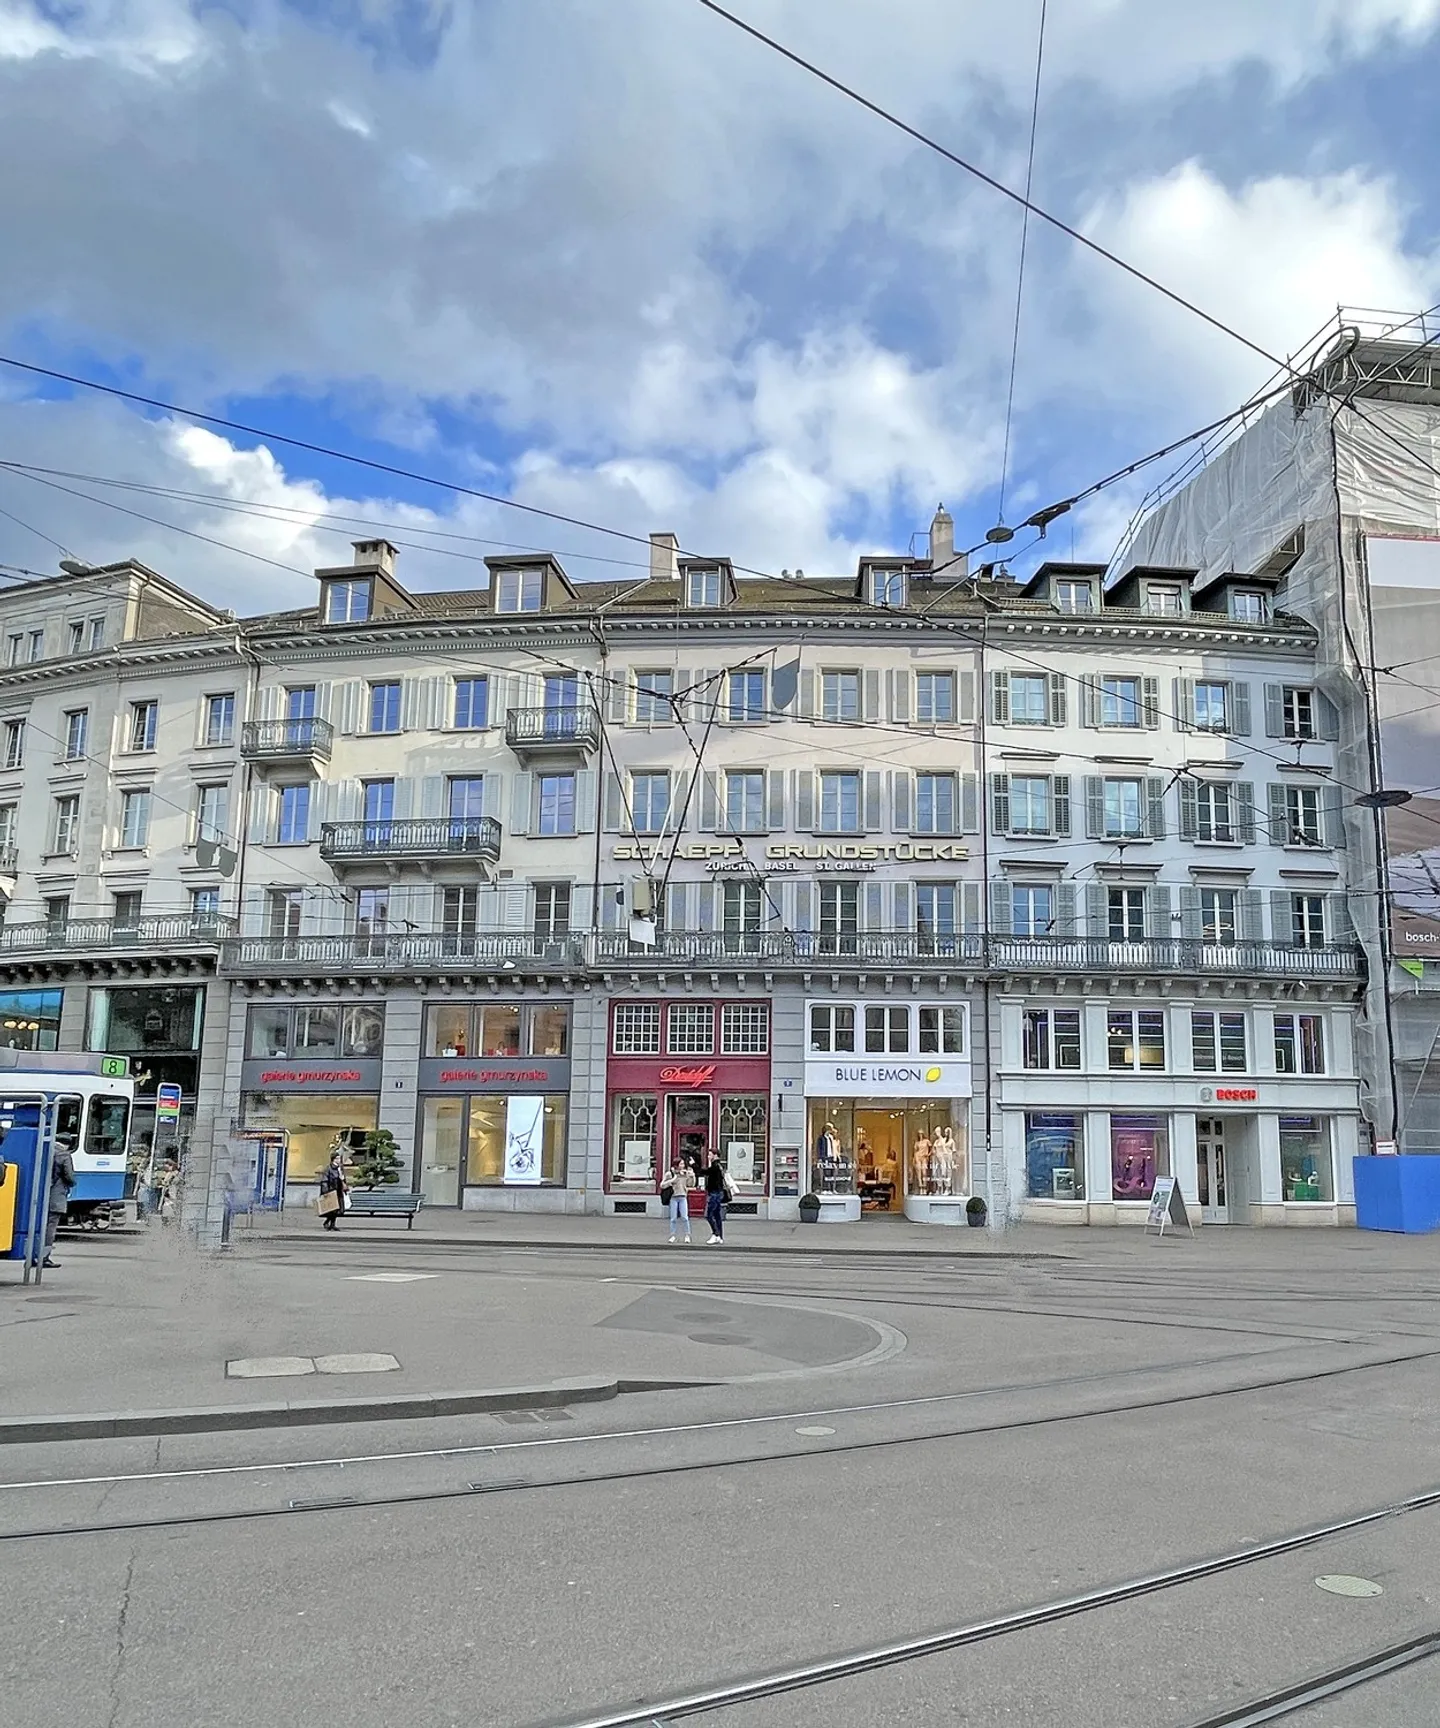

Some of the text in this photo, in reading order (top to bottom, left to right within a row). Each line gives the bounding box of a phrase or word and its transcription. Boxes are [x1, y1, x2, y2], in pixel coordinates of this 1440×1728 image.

[765, 842, 969, 861] GRUNDSTÜCKE
[764, 861, 800, 871] BASEL
[108, 1060, 118, 1074] 8
[836, 1067, 921, 1081] BLUE LEMON
[1216, 1088, 1257, 1101] BOSCH
